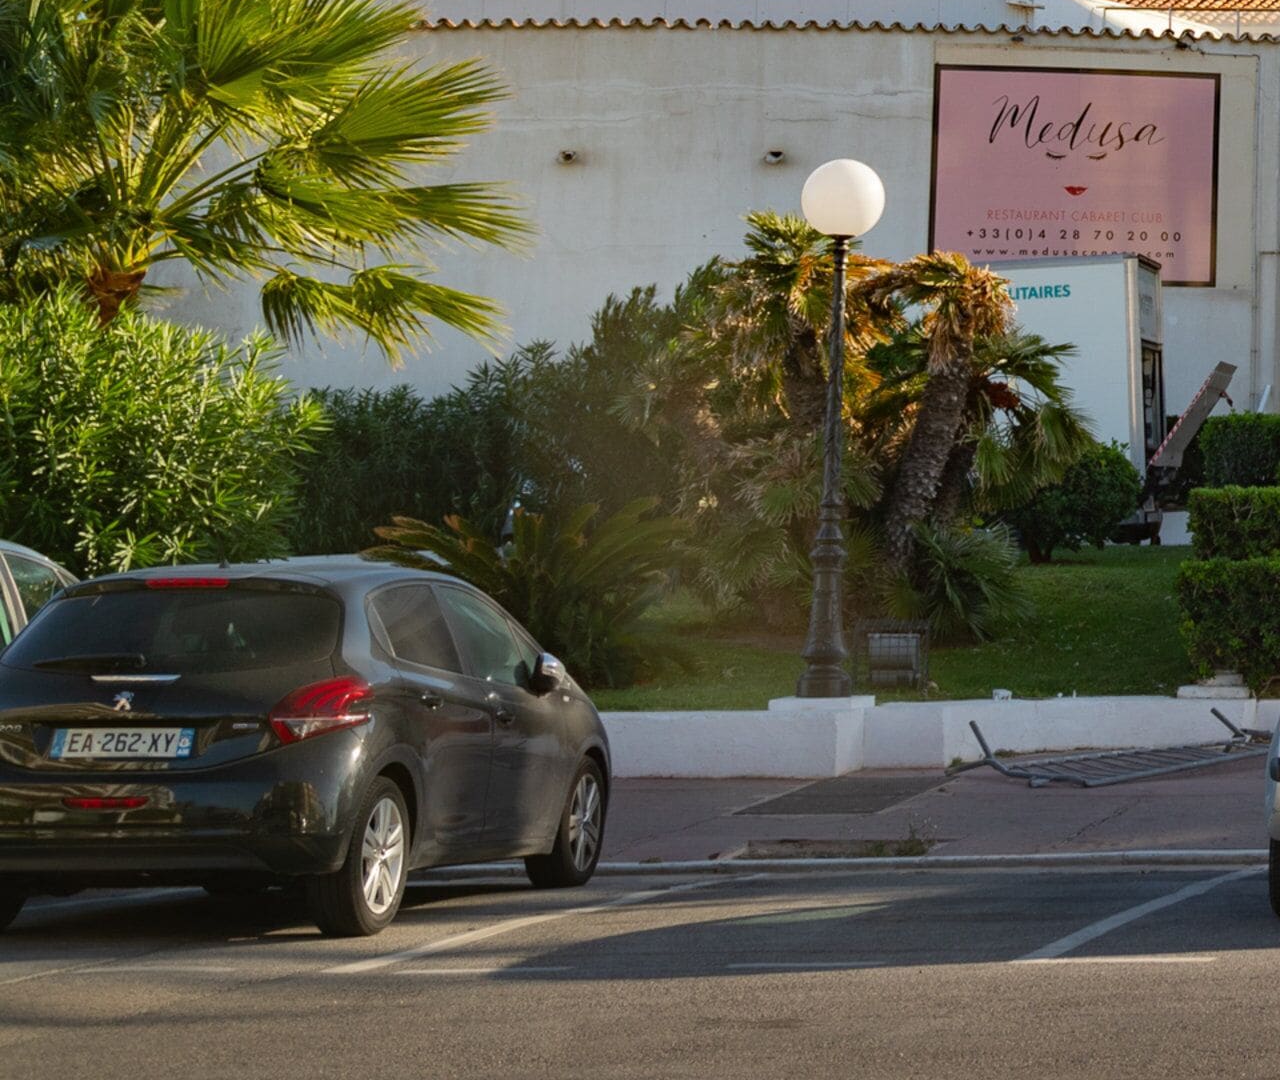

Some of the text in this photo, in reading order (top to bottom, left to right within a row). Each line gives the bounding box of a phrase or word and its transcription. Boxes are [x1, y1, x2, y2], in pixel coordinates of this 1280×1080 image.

[988, 94, 1166, 151] Medusa
[986, 208, 1066, 221] RESTAURANT
[966, 229, 1182, 243] +33(0)4 28 70 20 00
[67, 732, 177, 753] EA-262-XY
